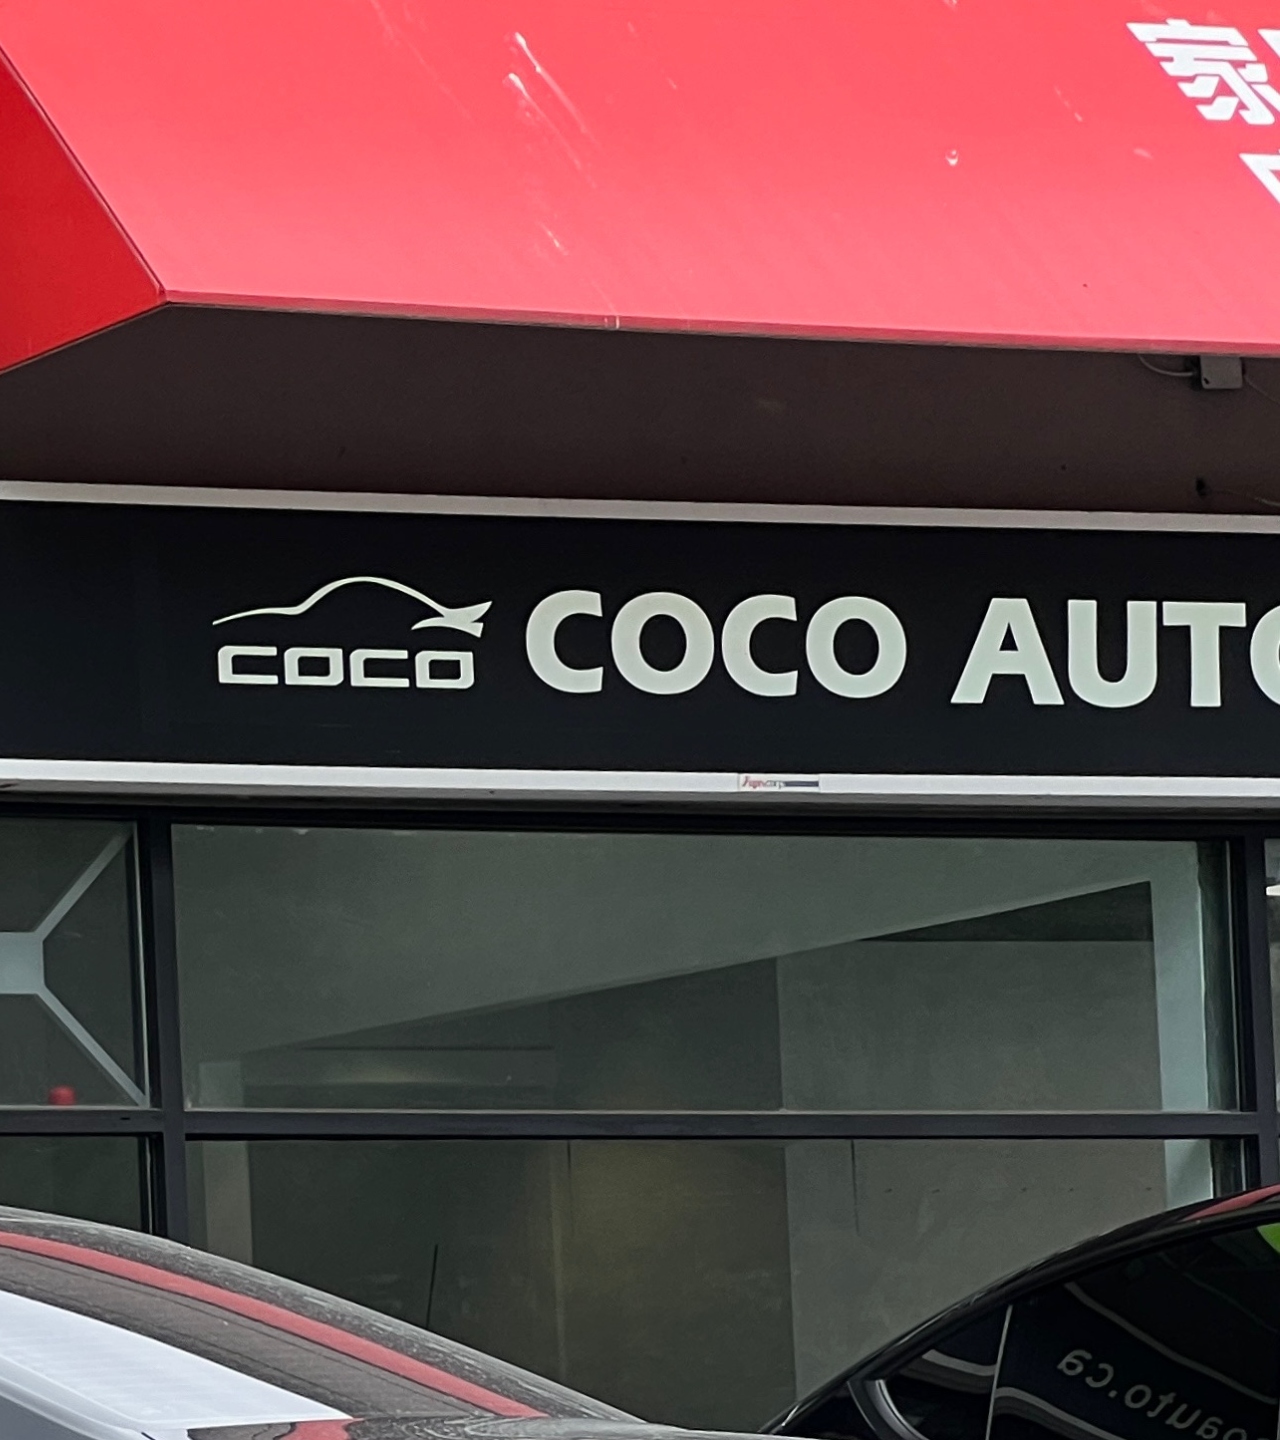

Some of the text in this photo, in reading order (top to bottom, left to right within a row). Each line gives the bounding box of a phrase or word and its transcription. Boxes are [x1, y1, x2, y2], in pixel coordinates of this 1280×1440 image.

[1126, 18, 1280, 126] 家
[217, 645, 475, 689] COCO
[525, 590, 907, 699] COCO
